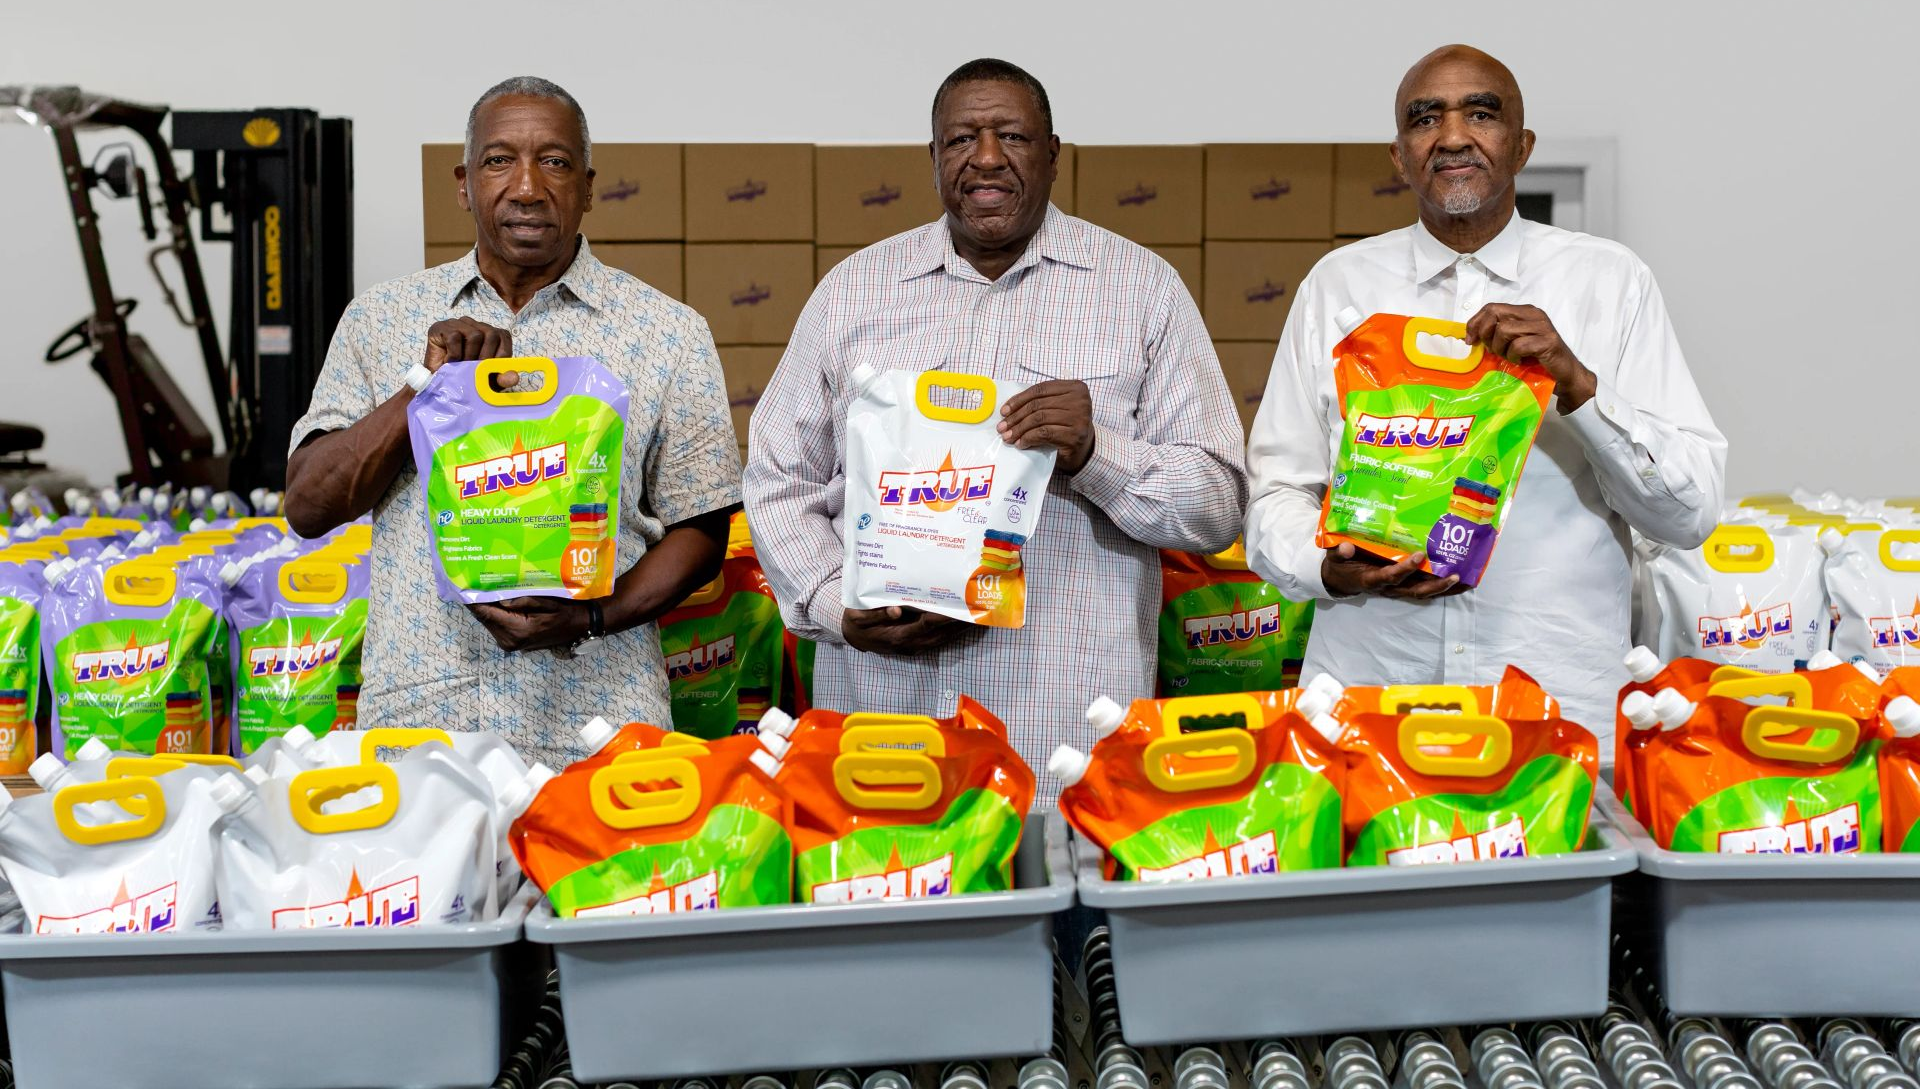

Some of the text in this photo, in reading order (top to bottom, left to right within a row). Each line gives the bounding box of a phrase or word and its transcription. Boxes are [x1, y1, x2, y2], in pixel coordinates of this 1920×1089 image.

[1354, 413, 1476, 449] TRUE
[455, 441, 567, 499] TRUE
[1349, 453, 1434, 480] FABRIC SOFTENER
[878, 465, 995, 506] TRUE
[460, 507, 520, 518] HEAVY DUTY
[461, 514, 567, 525] LIQUID LAUNDRY DETERGENT
[957, 506, 976, 515] FREE
[962, 514, 988, 525] CLEAR
[877, 528, 966, 544] LIQUID LAUNDRY DETERGENT
[1441, 522, 1475, 547] 101
[569, 547, 598, 567] 101
[1439, 540, 1470, 556] LOADS
[976, 573, 1002, 592] 101
[977, 591, 1003, 600] LOADS
[1184, 601, 1280, 650] TRUE
[1698, 602, 1793, 648] TRUE
[1869, 613, 1920, 649] TR
[72, 638, 171, 684] TRUE
[249, 635, 344, 678] TRUE
[663, 633, 736, 682] RUE
[1186, 657, 1263, 668] FABRIC SOFTENER
[74, 692, 124, 702] HEAVY DUTY
[674, 690, 719, 699] SOFTENER
[165, 729, 192, 748] 101
[1384, 816, 1529, 865] UE
[1138, 829, 1280, 881] UE
[575, 870, 720, 917] UE
